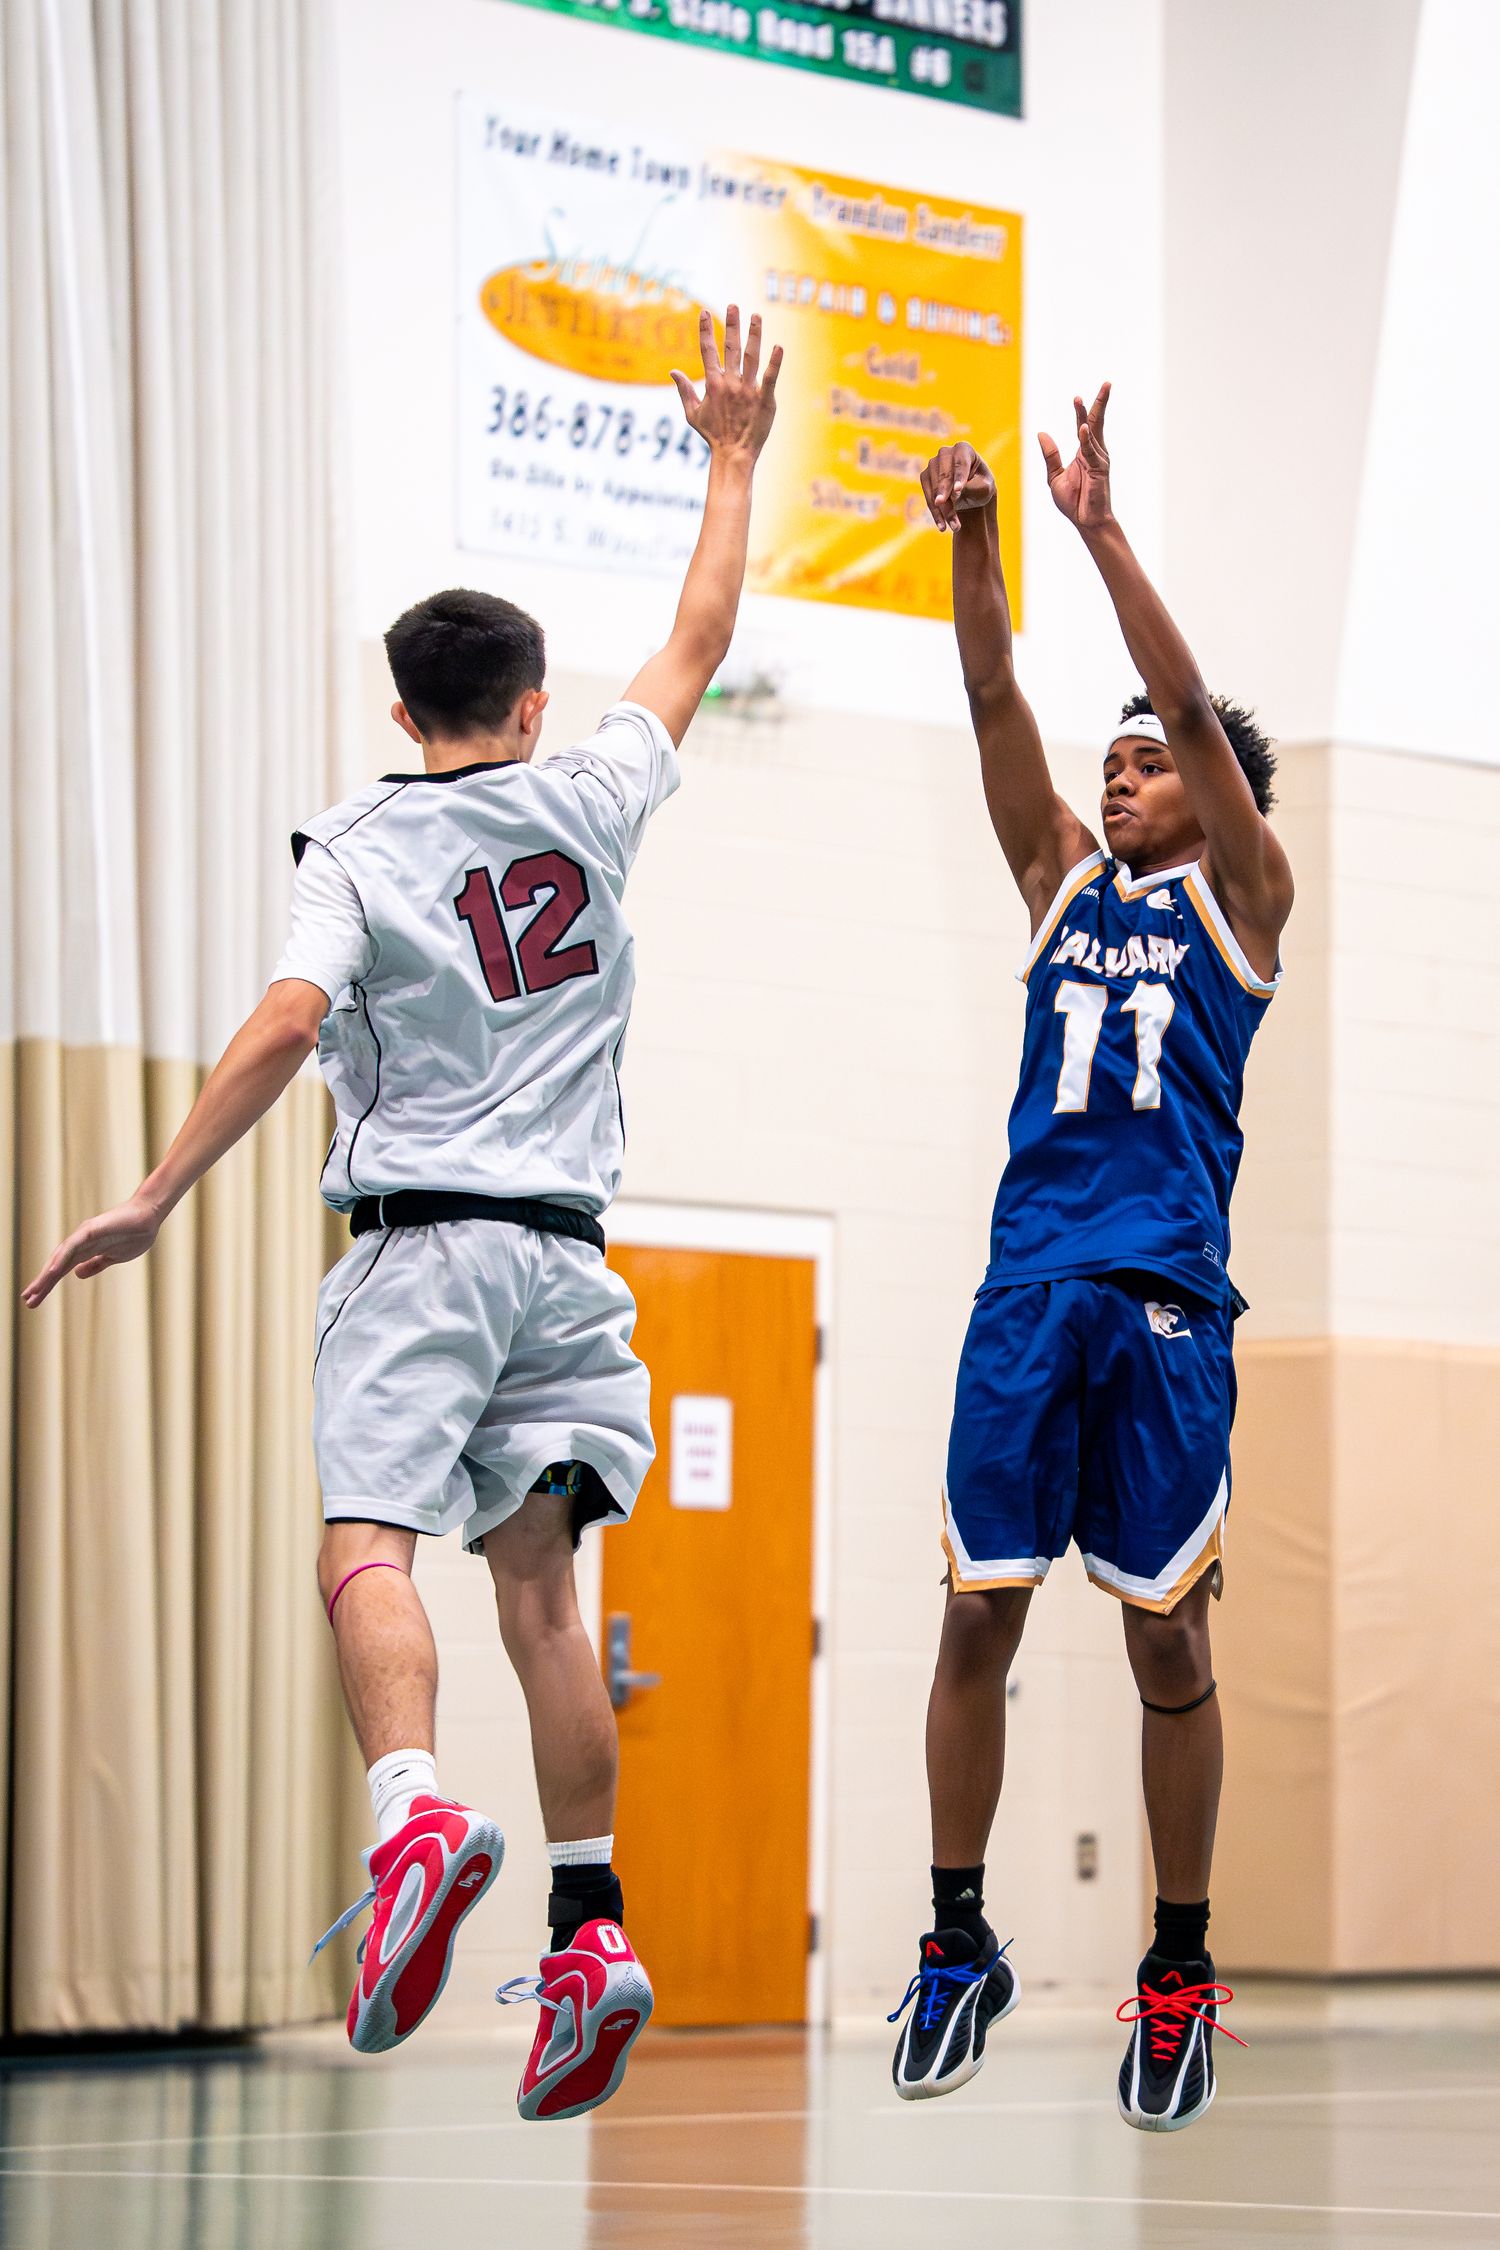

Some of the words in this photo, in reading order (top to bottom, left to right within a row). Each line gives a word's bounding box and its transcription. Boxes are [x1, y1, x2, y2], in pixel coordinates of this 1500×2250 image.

[756, 7, 833, 61] Road
[841, 28, 897, 75] 15A
[486, 113, 541, 157] Your
[548, 129, 619, 177] Home
[630, 145, 689, 191] Town
[699, 160, 787, 208] Jeweler
[766, 267, 867, 319] REPAIR
[877, 285, 896, 326] &
[453, 849, 599, 1003] 12
[1052, 979, 1176, 1115] 11
